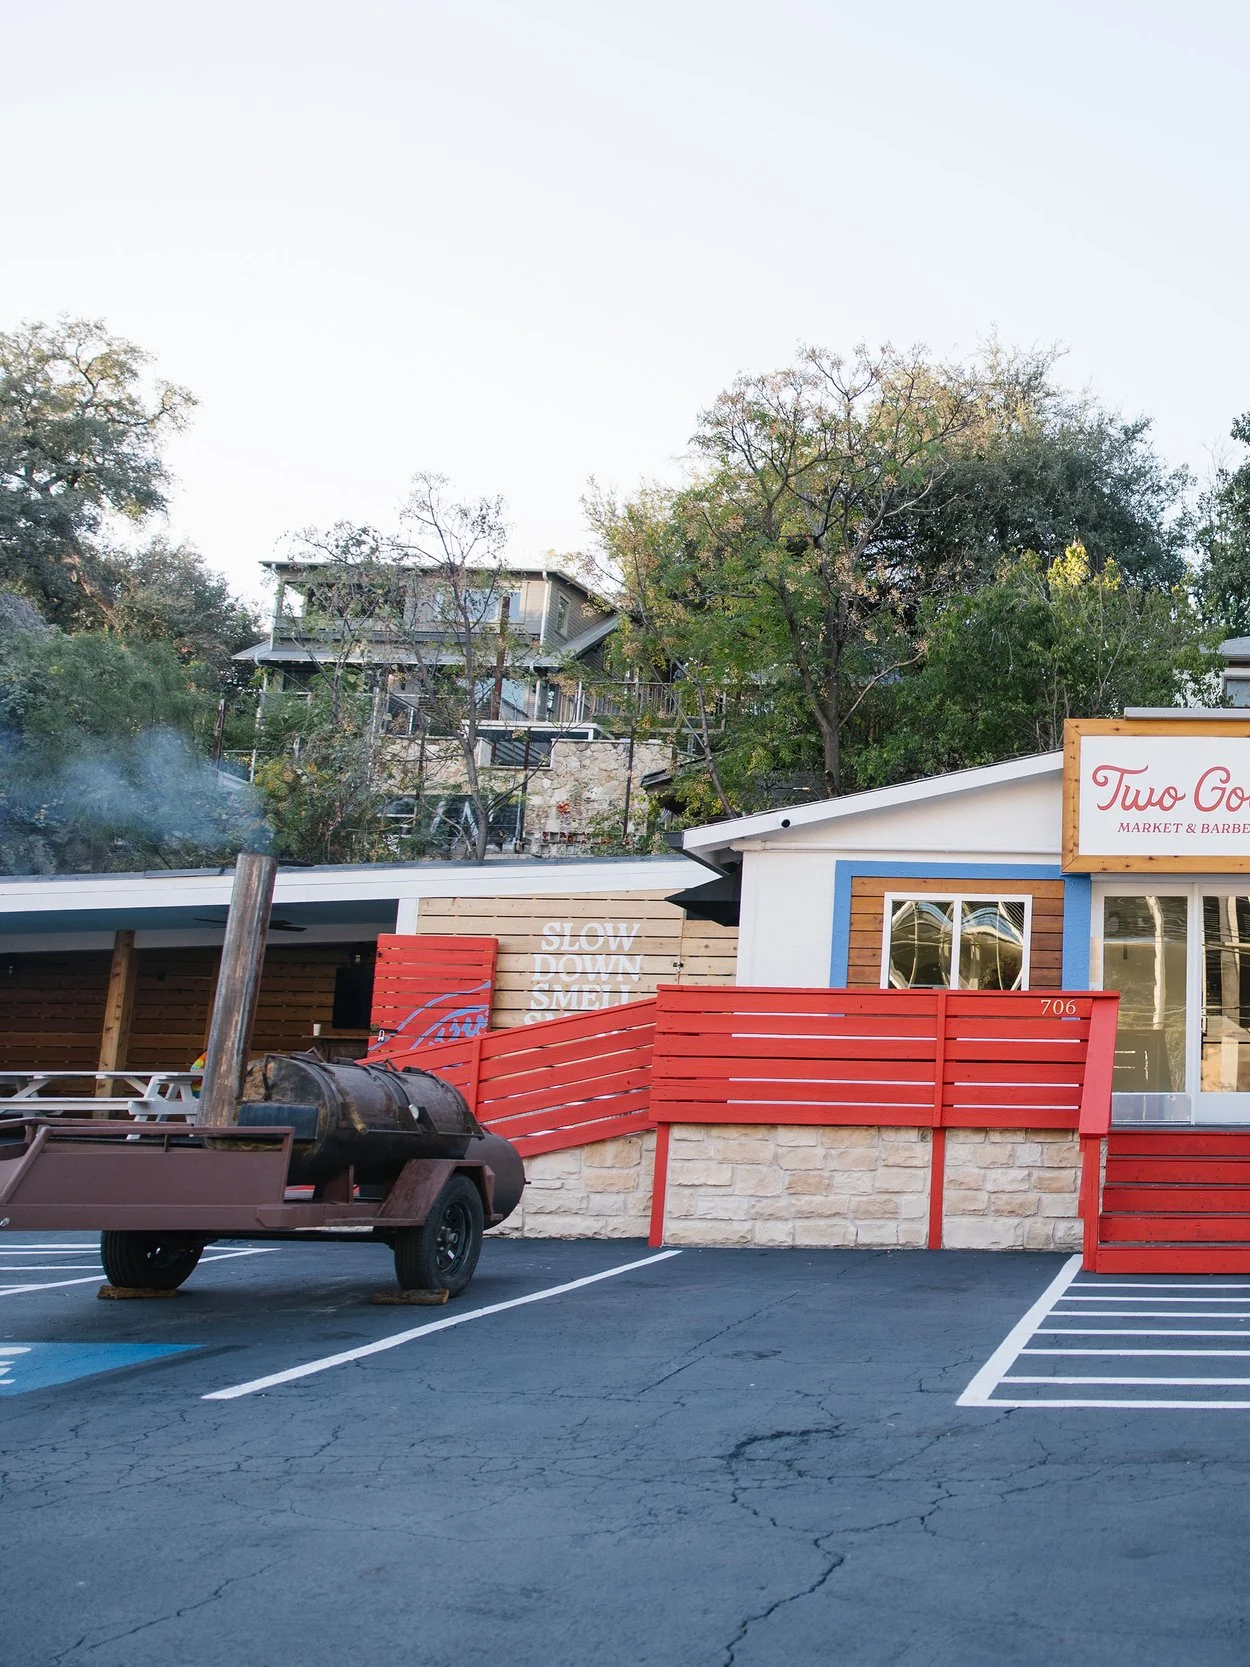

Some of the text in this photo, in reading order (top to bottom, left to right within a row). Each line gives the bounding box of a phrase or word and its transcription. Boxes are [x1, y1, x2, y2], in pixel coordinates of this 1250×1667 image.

[1091, 764, 1186, 811] Two
[1117, 822, 1184, 834] MARKET
[1186, 823, 1197, 834] &
[540, 922, 641, 951] SLOW
[531, 953, 643, 982] DOWN
[1040, 999, 1077, 1015] 706
